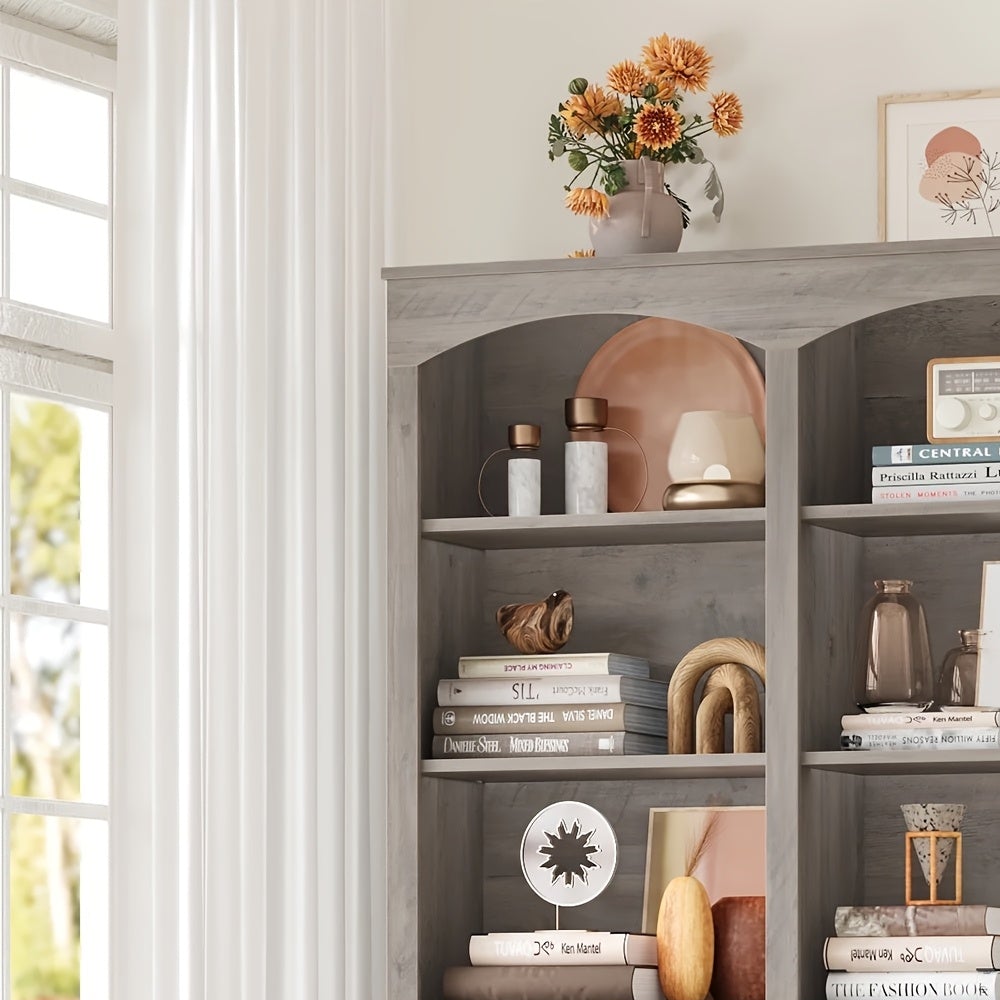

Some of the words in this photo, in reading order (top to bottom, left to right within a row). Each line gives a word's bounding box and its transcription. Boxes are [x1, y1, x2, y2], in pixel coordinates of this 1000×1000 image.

[919, 446, 991, 459] CENTRAL
[880, 472, 925, 483] Priscilla
[930, 470, 977, 481] Rattazzi
[917, 489, 958, 498] MOMENTS
[504, 664, 526, 672] PLACE
[538, 662, 573, 671] CLAIMING
[512, 683, 539, 700] 'TIS
[552, 686, 586, 696] McCourt
[588, 686, 608, 696] Frank
[472, 713, 506, 725] WIDOW
[506, 712, 537, 724] BLACK
[538, 711, 555, 722] THE
[562, 710, 585, 721] SILVA
[587, 708, 614, 720] DANIEL
[933, 715, 947, 723] Ken
[948, 715, 973, 723] Mantel
[902, 736, 938, 745] REASONS
[941, 735, 973, 744] MILLION
[976, 735, 996, 743] FIFTY
[561, 943, 575, 954] Ken
[577, 942, 602, 954] Mantel
[851, 949, 877, 962] Mantel
[878, 949, 893, 960] Ken
[832, 983, 865, 998] THE
[869, 983, 938, 998] FASHION
[943, 983, 989, 997] BOOK
